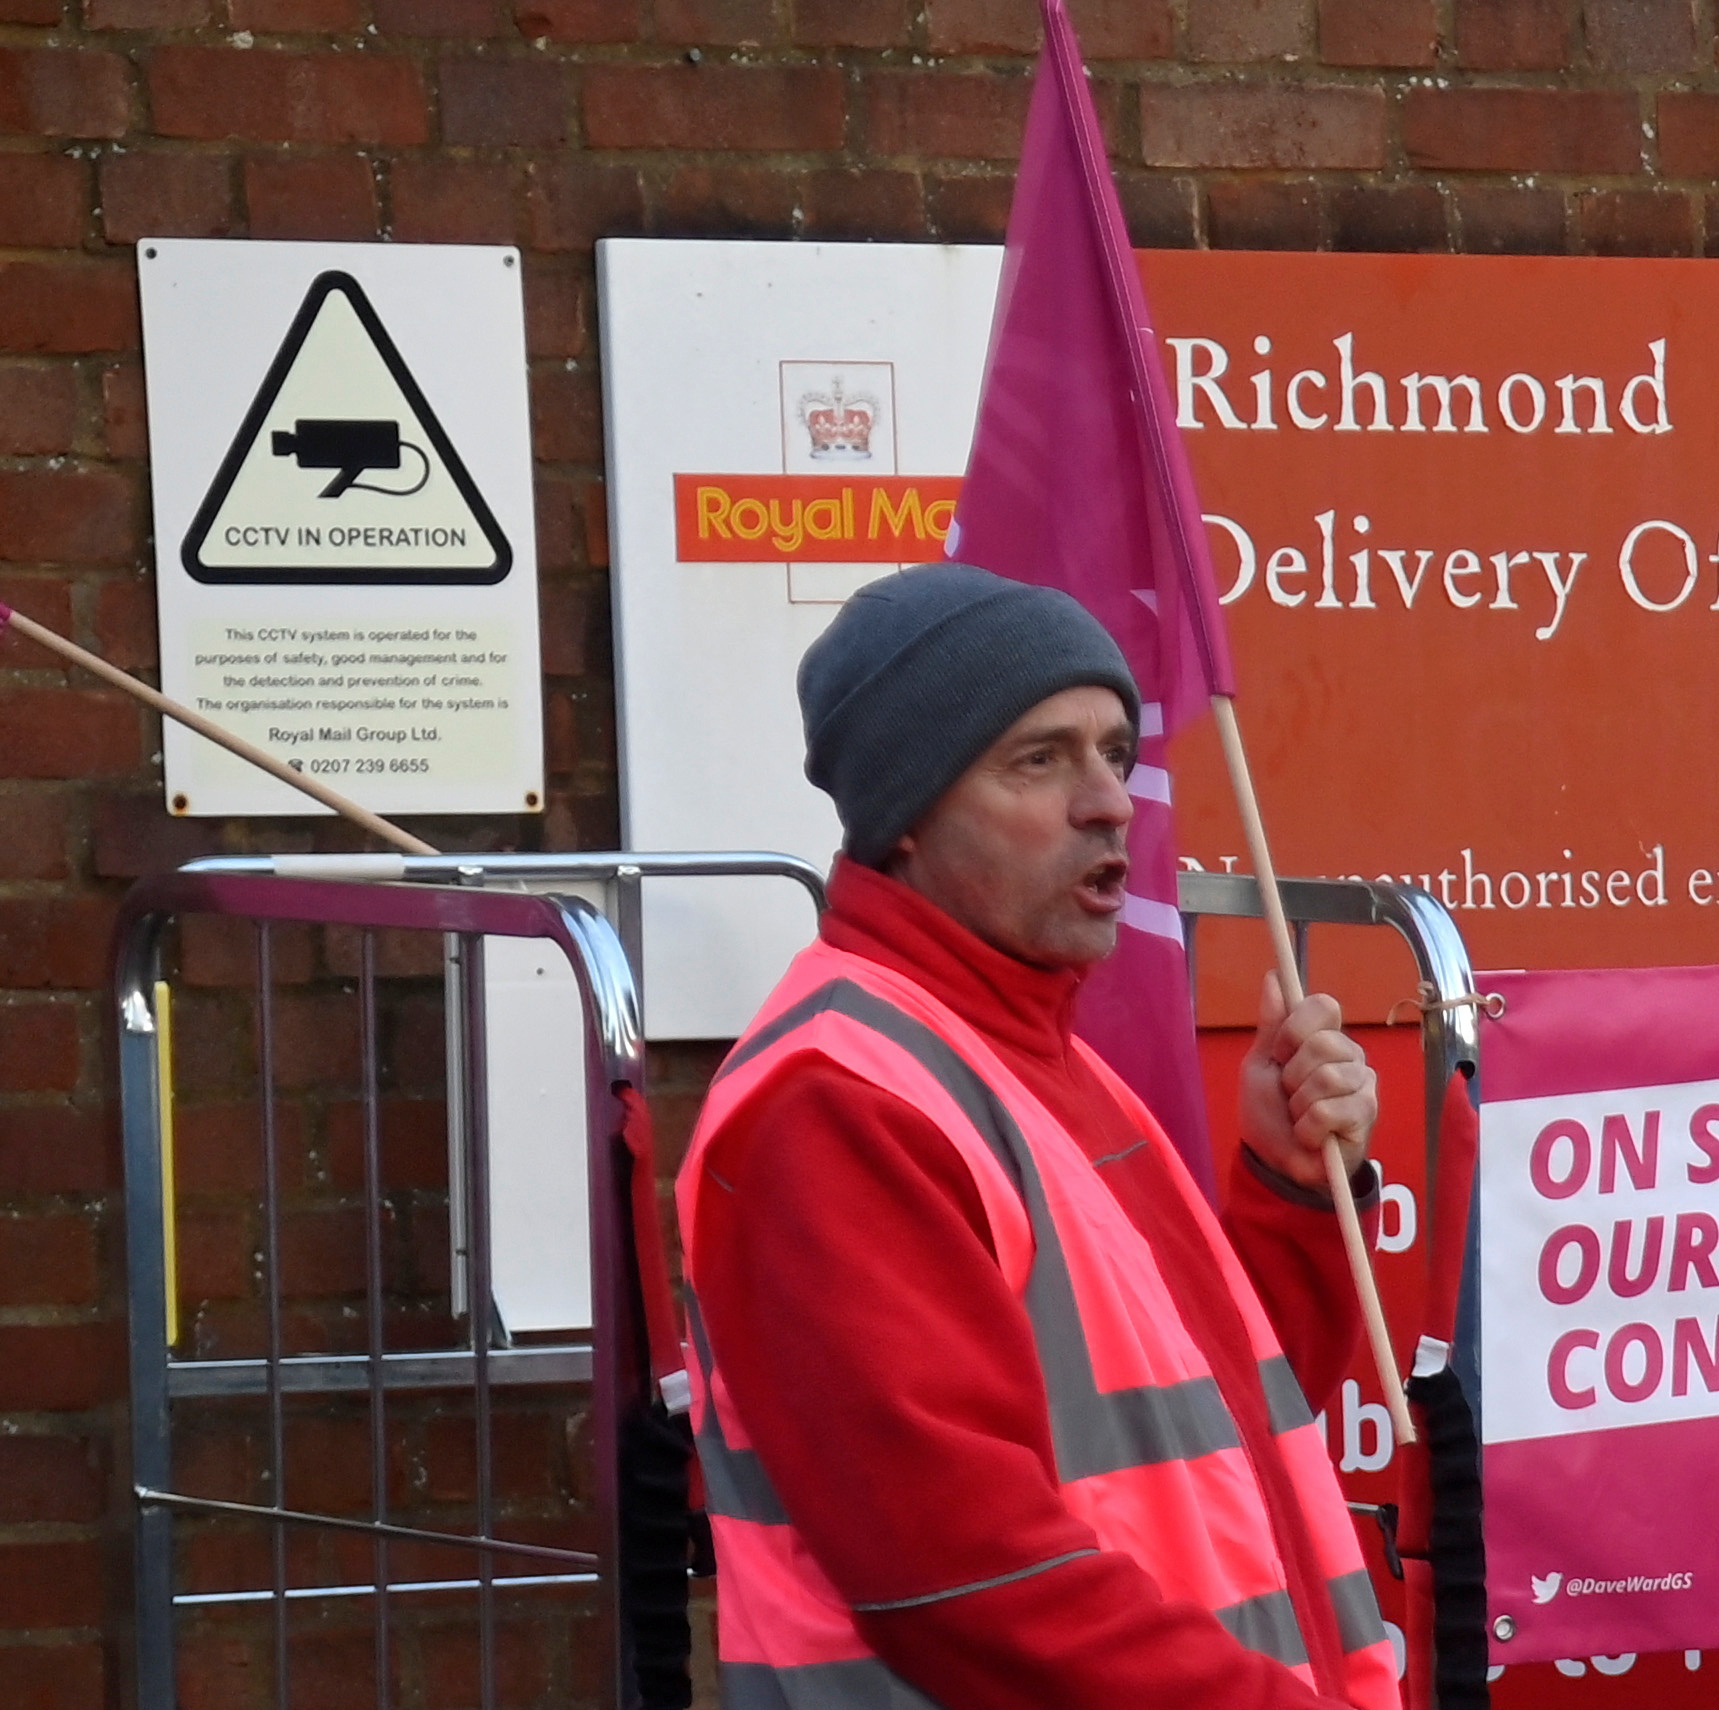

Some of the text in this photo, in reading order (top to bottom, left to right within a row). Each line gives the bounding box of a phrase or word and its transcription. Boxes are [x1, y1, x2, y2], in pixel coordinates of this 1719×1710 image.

[1165, 332, 1674, 435] Richmond
[697, 487, 854, 552] Royal
[225, 527, 466, 547] CCTV IN OPERATION
[1200, 510, 1587, 641] Delivery
[225, 629, 477, 643] This CCTV system is operated for the
[195, 652, 507, 667] purposes of safety, good management and for
[223, 675, 483, 690] the detection and prevention of crime.
[196, 697, 509, 712] The organisation responsible for the system is
[269, 727, 442, 746] Royal Mail Group Ltd.
[310, 759, 429, 773] 0207 239 6655
[1529, 1112, 1661, 1200] ON
[1537, 1208, 1719, 1306] OUR
[1565, 1571, 1694, 1597] @DaveWardGS
